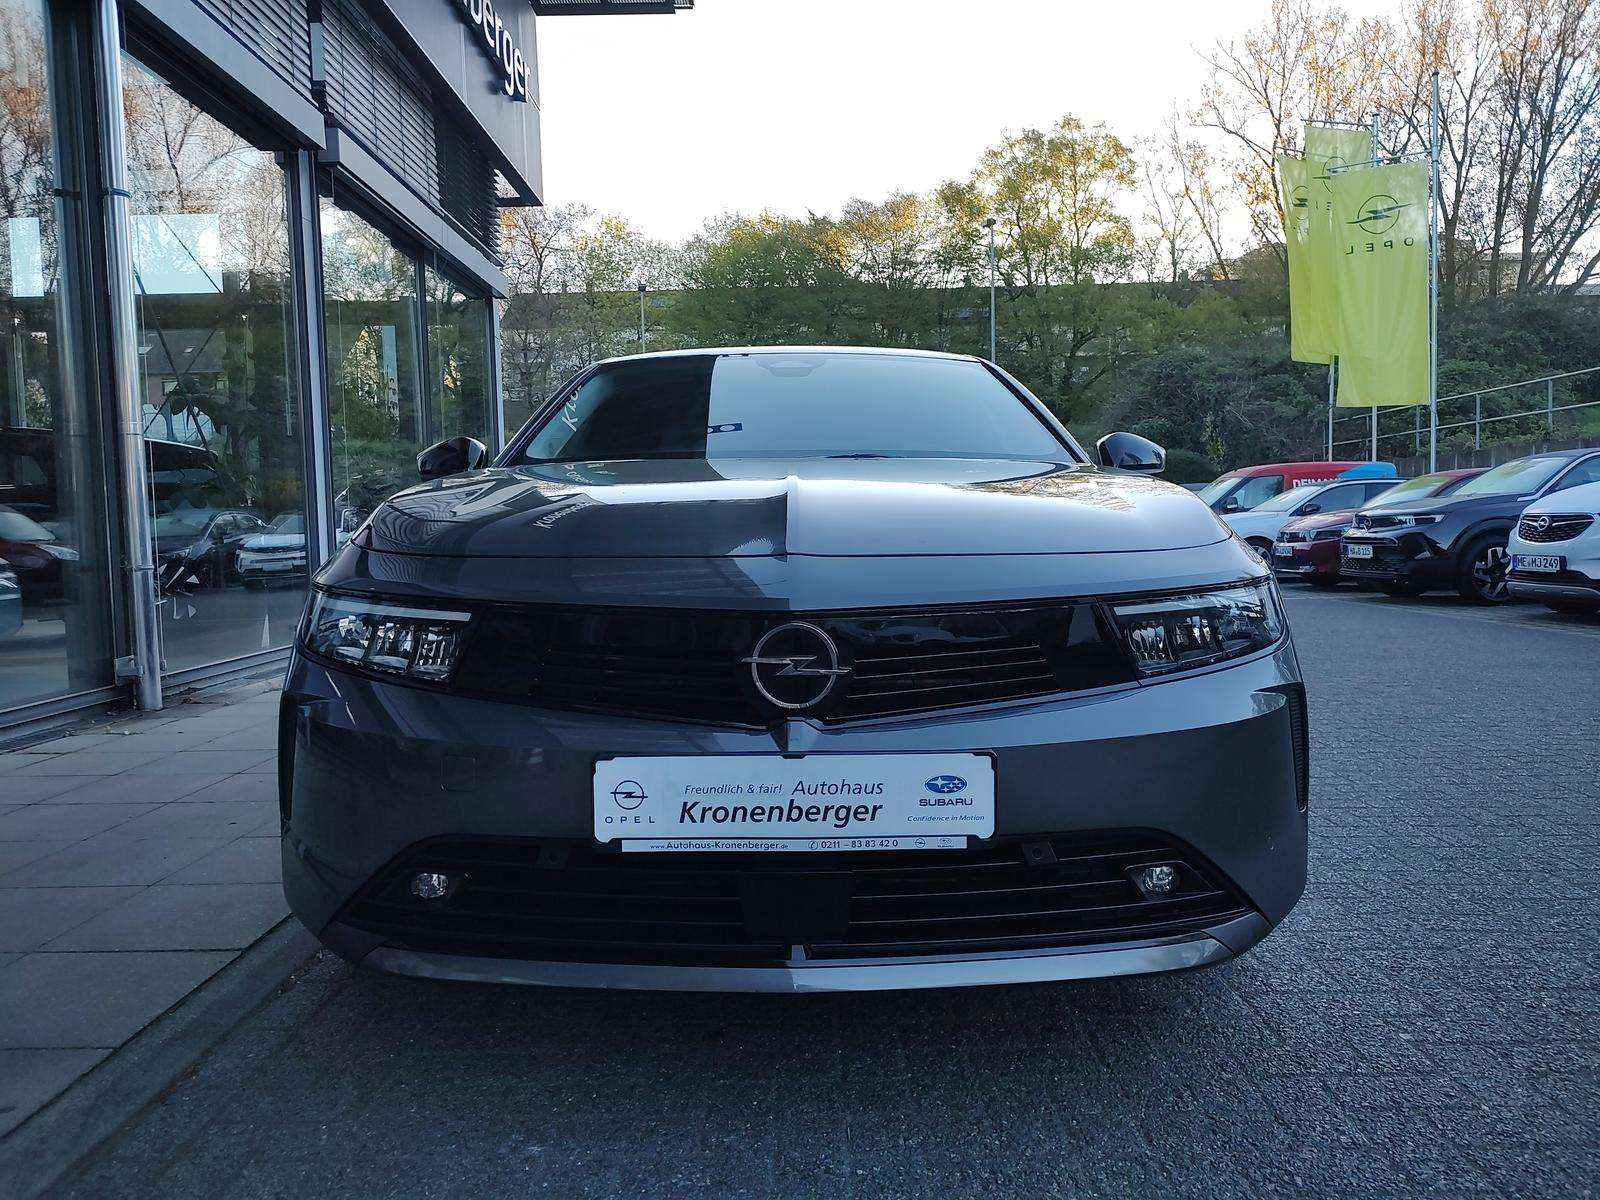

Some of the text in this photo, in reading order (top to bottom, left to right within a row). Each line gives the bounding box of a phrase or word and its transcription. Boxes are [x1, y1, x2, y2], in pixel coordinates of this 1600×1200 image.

[1543, 557, 1559, 569] 249
[684, 778, 884, 796] Freundlich & fair! Autohaus
[918, 797, 973, 807] SUBARU
[679, 798, 884, 829] Kronenberger
[959, 814, 985, 822] Motion
[604, 815, 656, 824] OPEL
[821, 840, 841, 849] 0211
[851, 839, 862, 848] 83
[864, 839, 876, 848] 83
[878, 839, 890, 848] 42
[892, 839, 898, 848] 0
